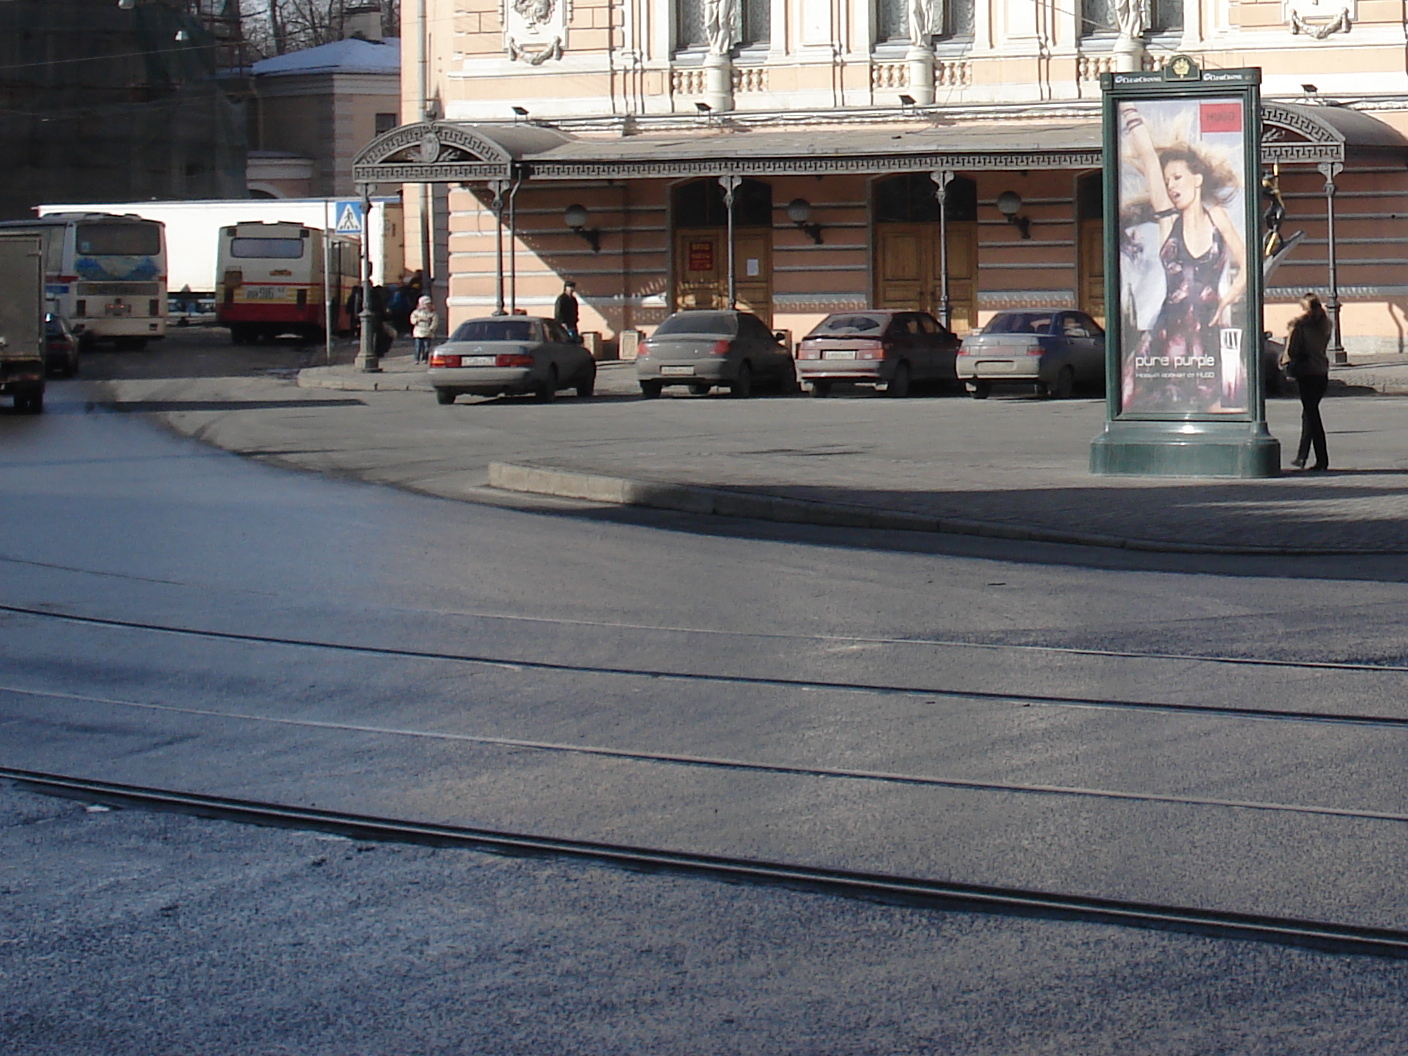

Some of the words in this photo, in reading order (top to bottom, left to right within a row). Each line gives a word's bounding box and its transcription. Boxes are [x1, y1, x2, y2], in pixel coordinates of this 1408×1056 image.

[1206, 111, 1235, 122] HUGO
[1135, 355, 1170, 369] pure
[1174, 354, 1215, 369] purple
